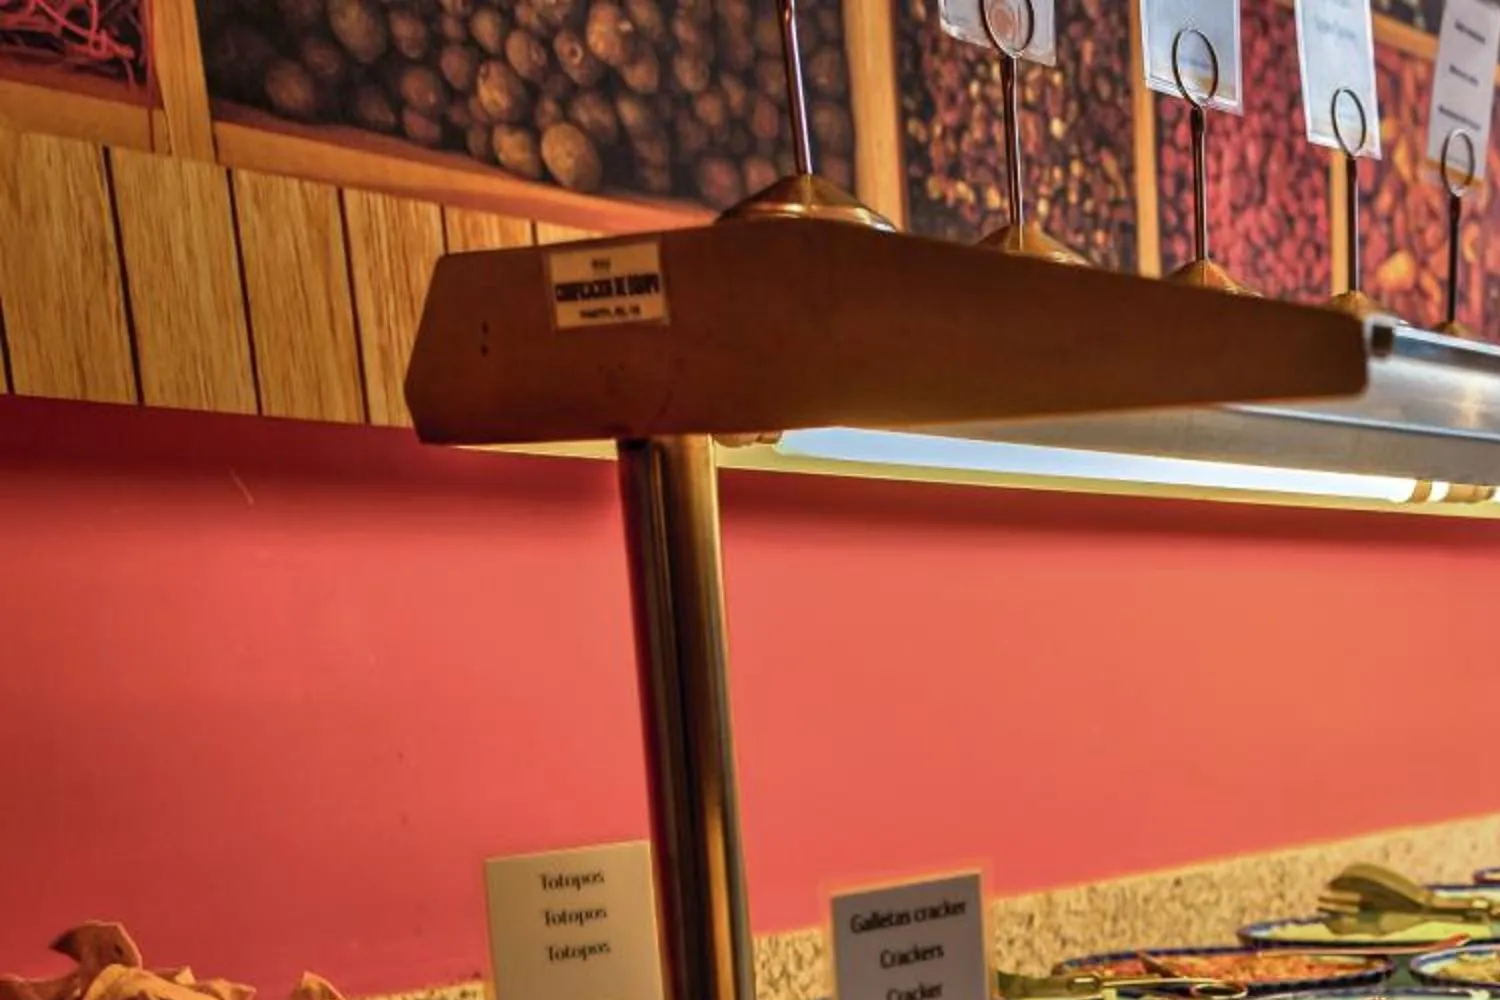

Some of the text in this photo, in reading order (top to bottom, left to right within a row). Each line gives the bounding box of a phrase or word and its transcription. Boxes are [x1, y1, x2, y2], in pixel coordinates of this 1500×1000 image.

[539, 871, 605, 892] Totopos
[543, 907, 608, 927] Totopos
[850, 900, 967, 934] Galletas cracker
[546, 942, 612, 961] Totopos
[880, 944, 945, 969] Crackers
